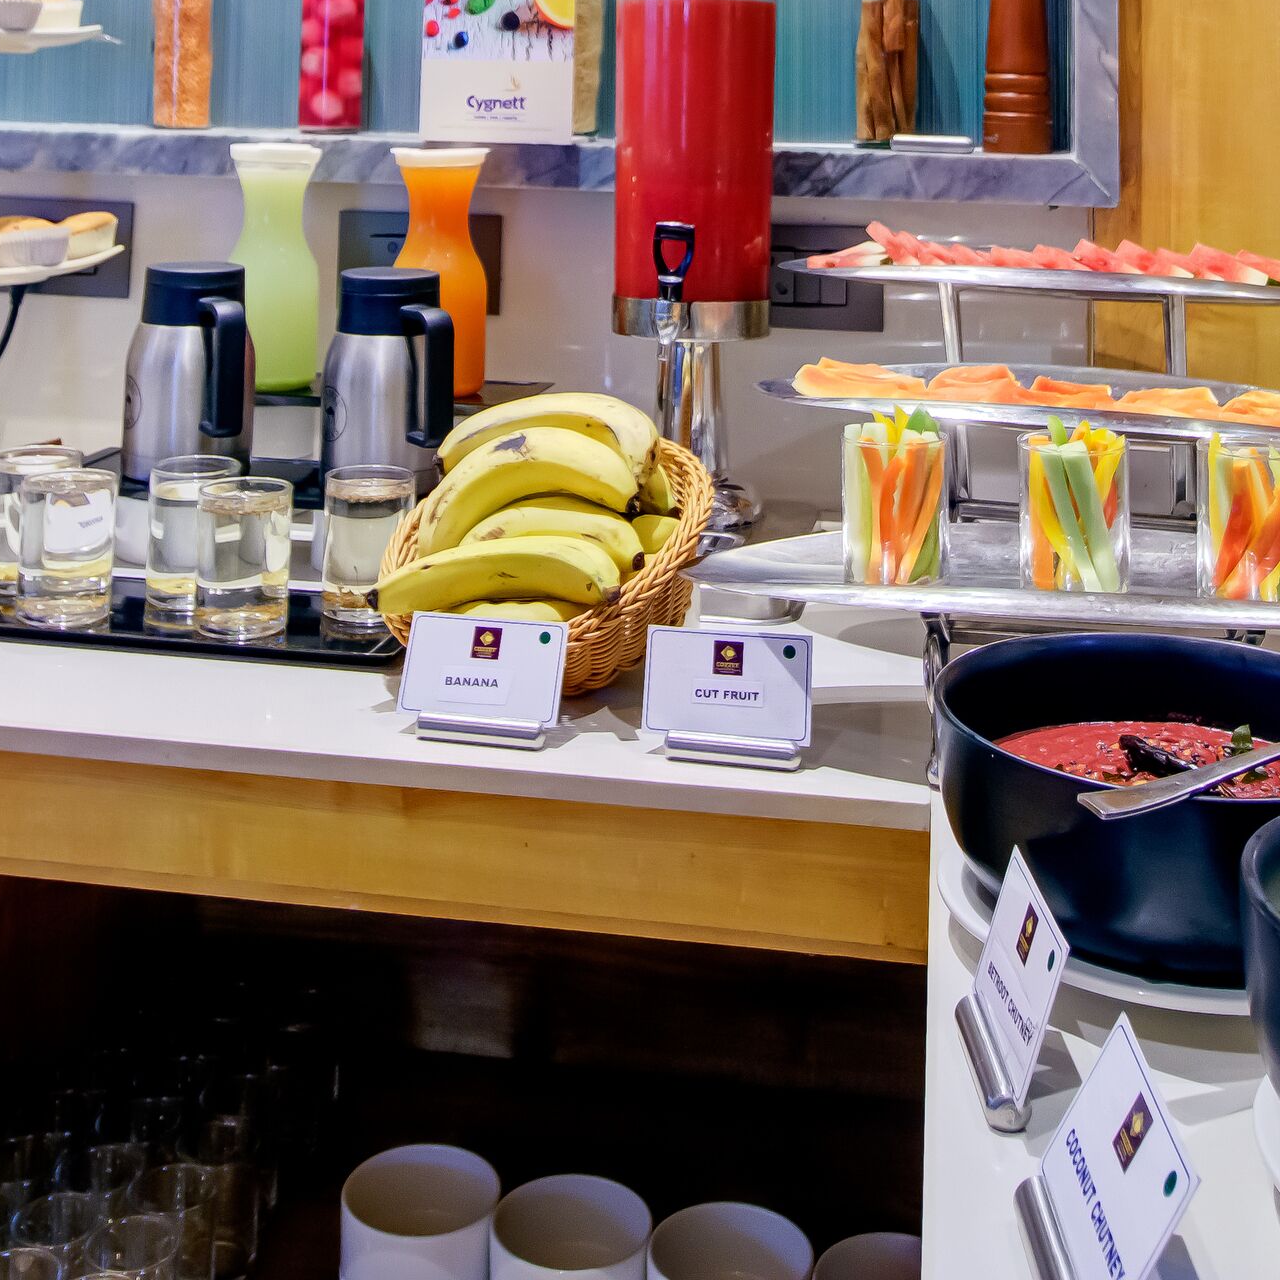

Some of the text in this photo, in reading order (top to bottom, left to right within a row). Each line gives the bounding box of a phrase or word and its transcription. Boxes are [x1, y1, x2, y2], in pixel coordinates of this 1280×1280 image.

[467, 95, 526, 112] Cygnett
[445, 676, 498, 688] BANANA
[695, 688, 759, 701] CUT FRUIT
[1007, 998, 1033, 1046] CHUTNEY
[1066, 1128, 1096, 1205] COCONUT
[1091, 1200, 1126, 1280] CHUTNEY
